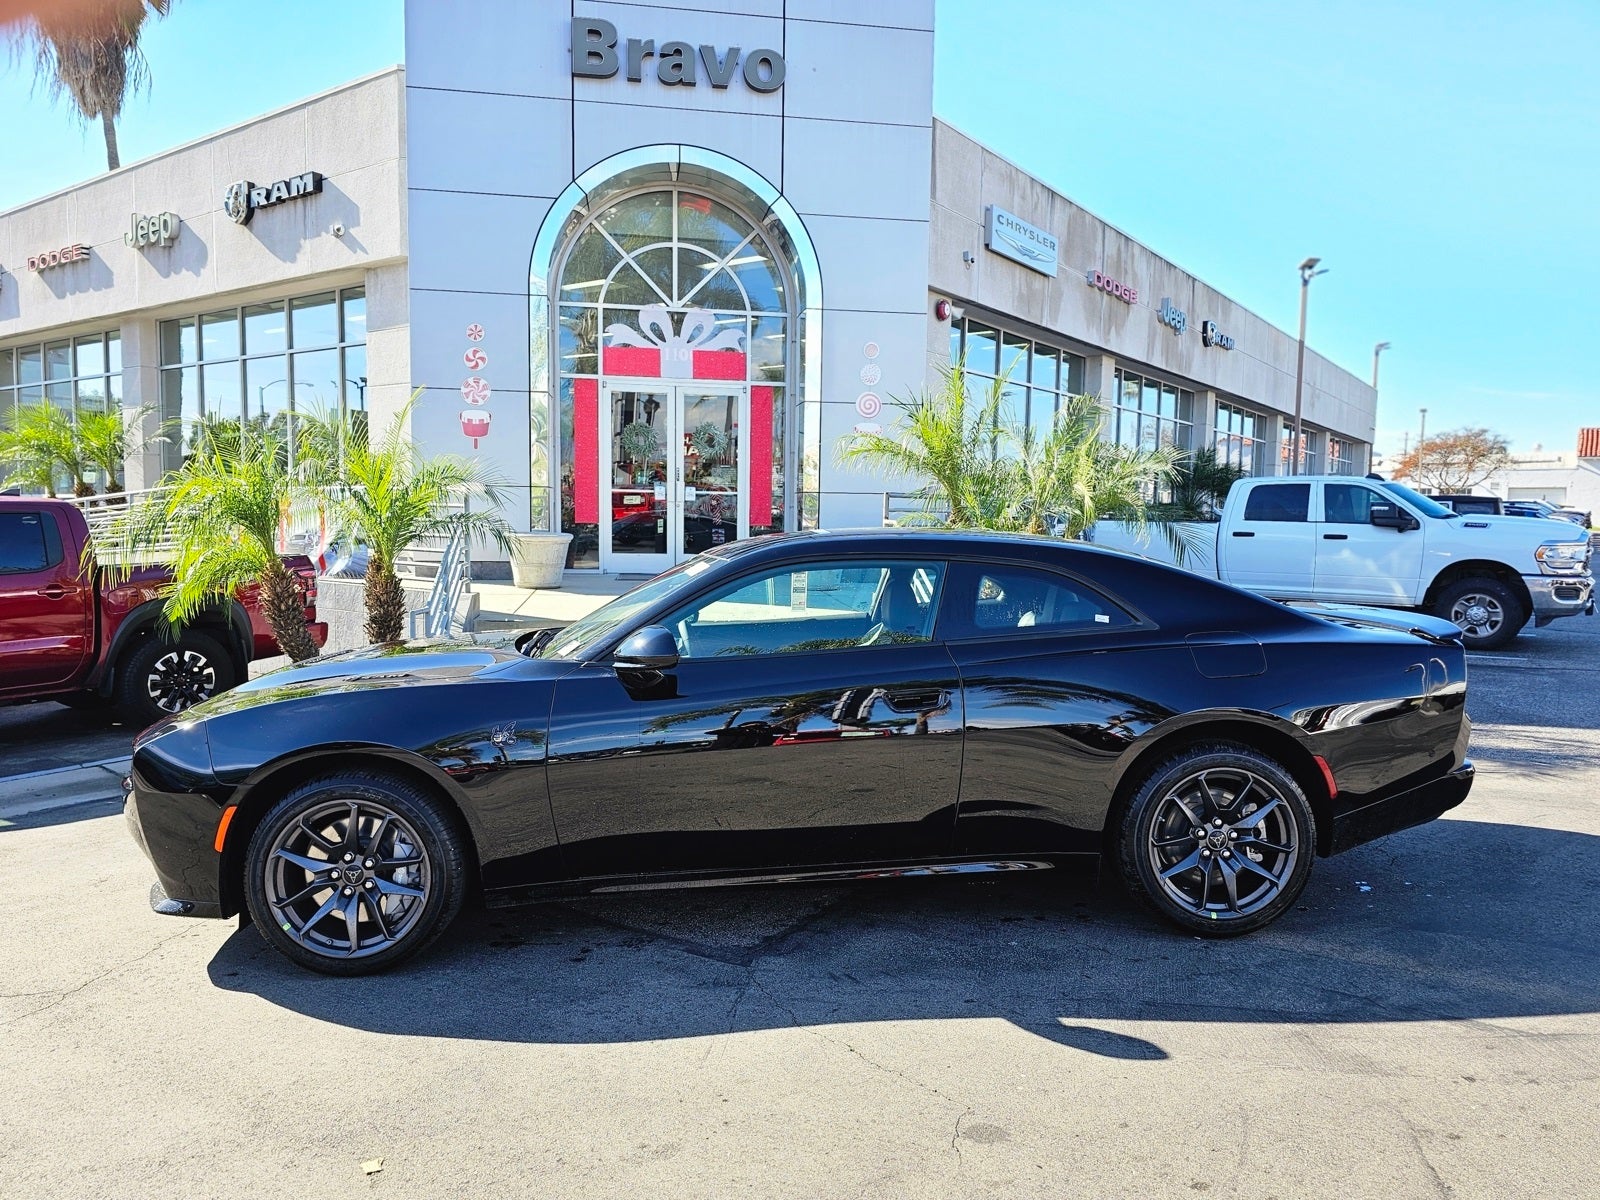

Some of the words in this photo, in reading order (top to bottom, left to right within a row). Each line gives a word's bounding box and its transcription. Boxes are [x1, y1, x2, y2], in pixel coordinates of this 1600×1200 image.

[571, 16, 786, 93] Bravo
[250, 171, 321, 209] RAM
[124, 211, 180, 248] Jeep
[997, 214, 1056, 251] CHRYSLER
[28, 243, 88, 272] DODGE
[1092, 270, 1138, 305] DODGE
[1159, 297, 1188, 336] Jeep
[1215, 332, 1236, 350] RAM
